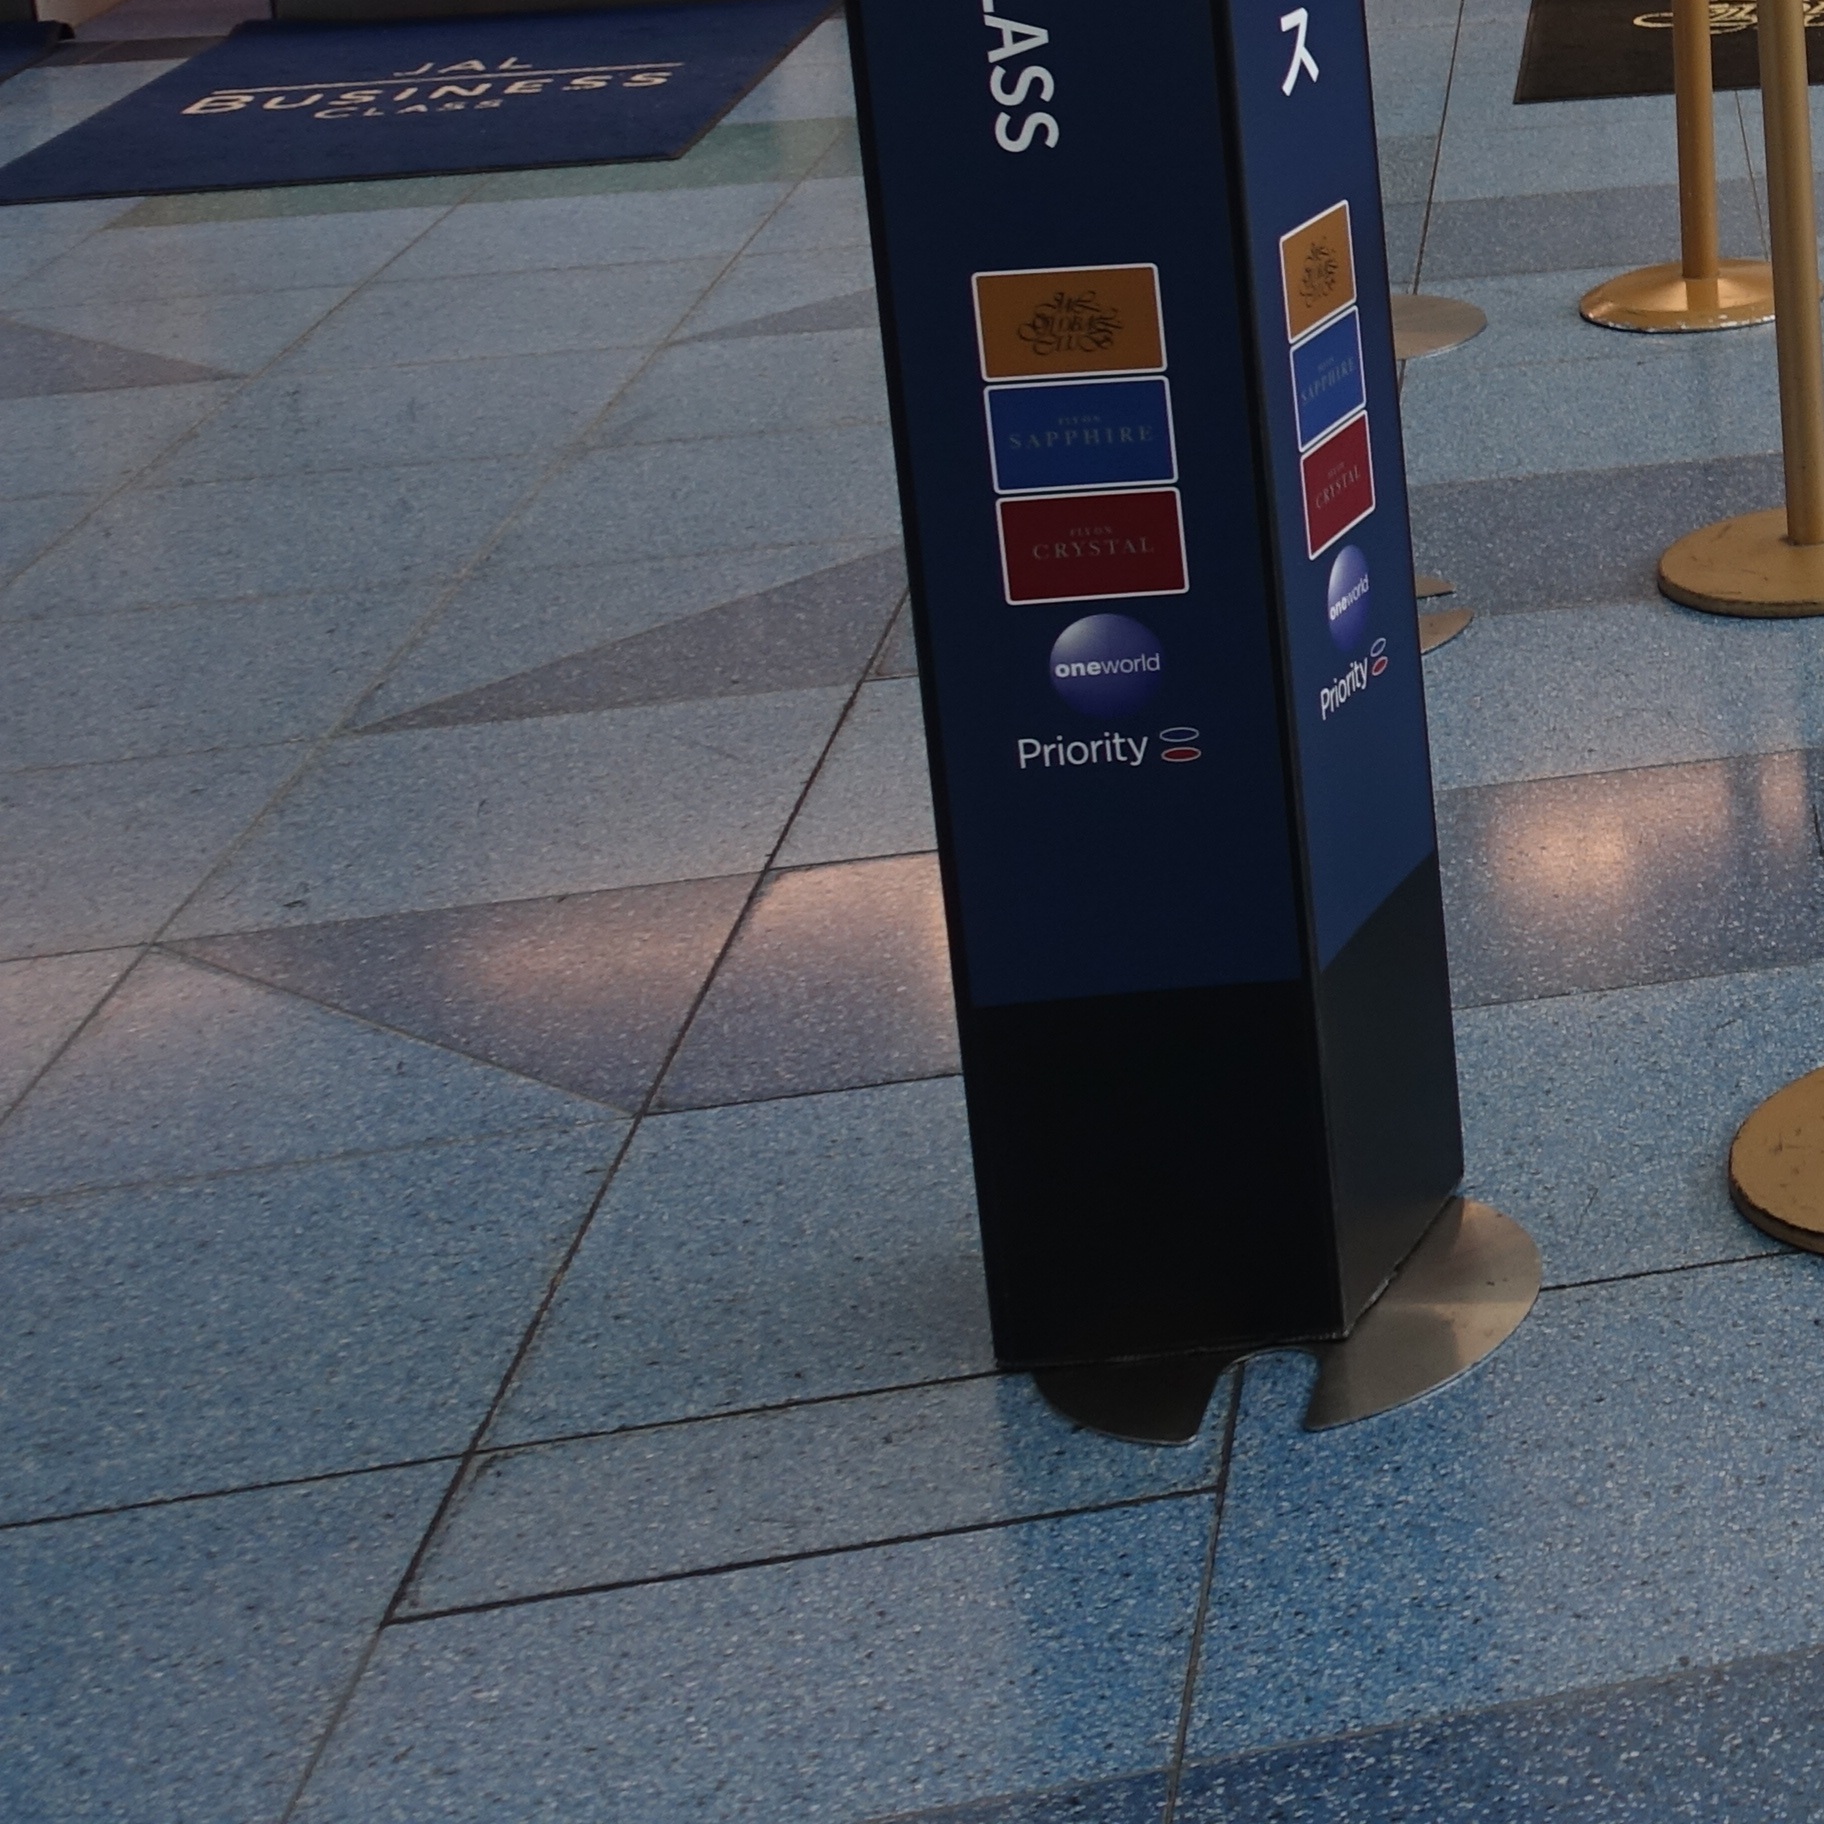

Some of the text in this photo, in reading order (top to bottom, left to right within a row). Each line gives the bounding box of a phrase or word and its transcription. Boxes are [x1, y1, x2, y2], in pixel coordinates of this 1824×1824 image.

[392, 56, 534, 78] JAL
[181, 70, 674, 116] BUSINESS
[312, 98, 506, 121] CLASS
[1009, 425, 1155, 451] SAPPHIRE
[1314, 466, 1362, 509] CRYSTAL
[1033, 535, 1155, 562] CRYSTAL
[1328, 574, 1370, 621] oneworld
[1054, 653, 1161, 679] oneworld
[1319, 655, 1370, 721] Priority
[1017, 731, 1149, 770] Priority
